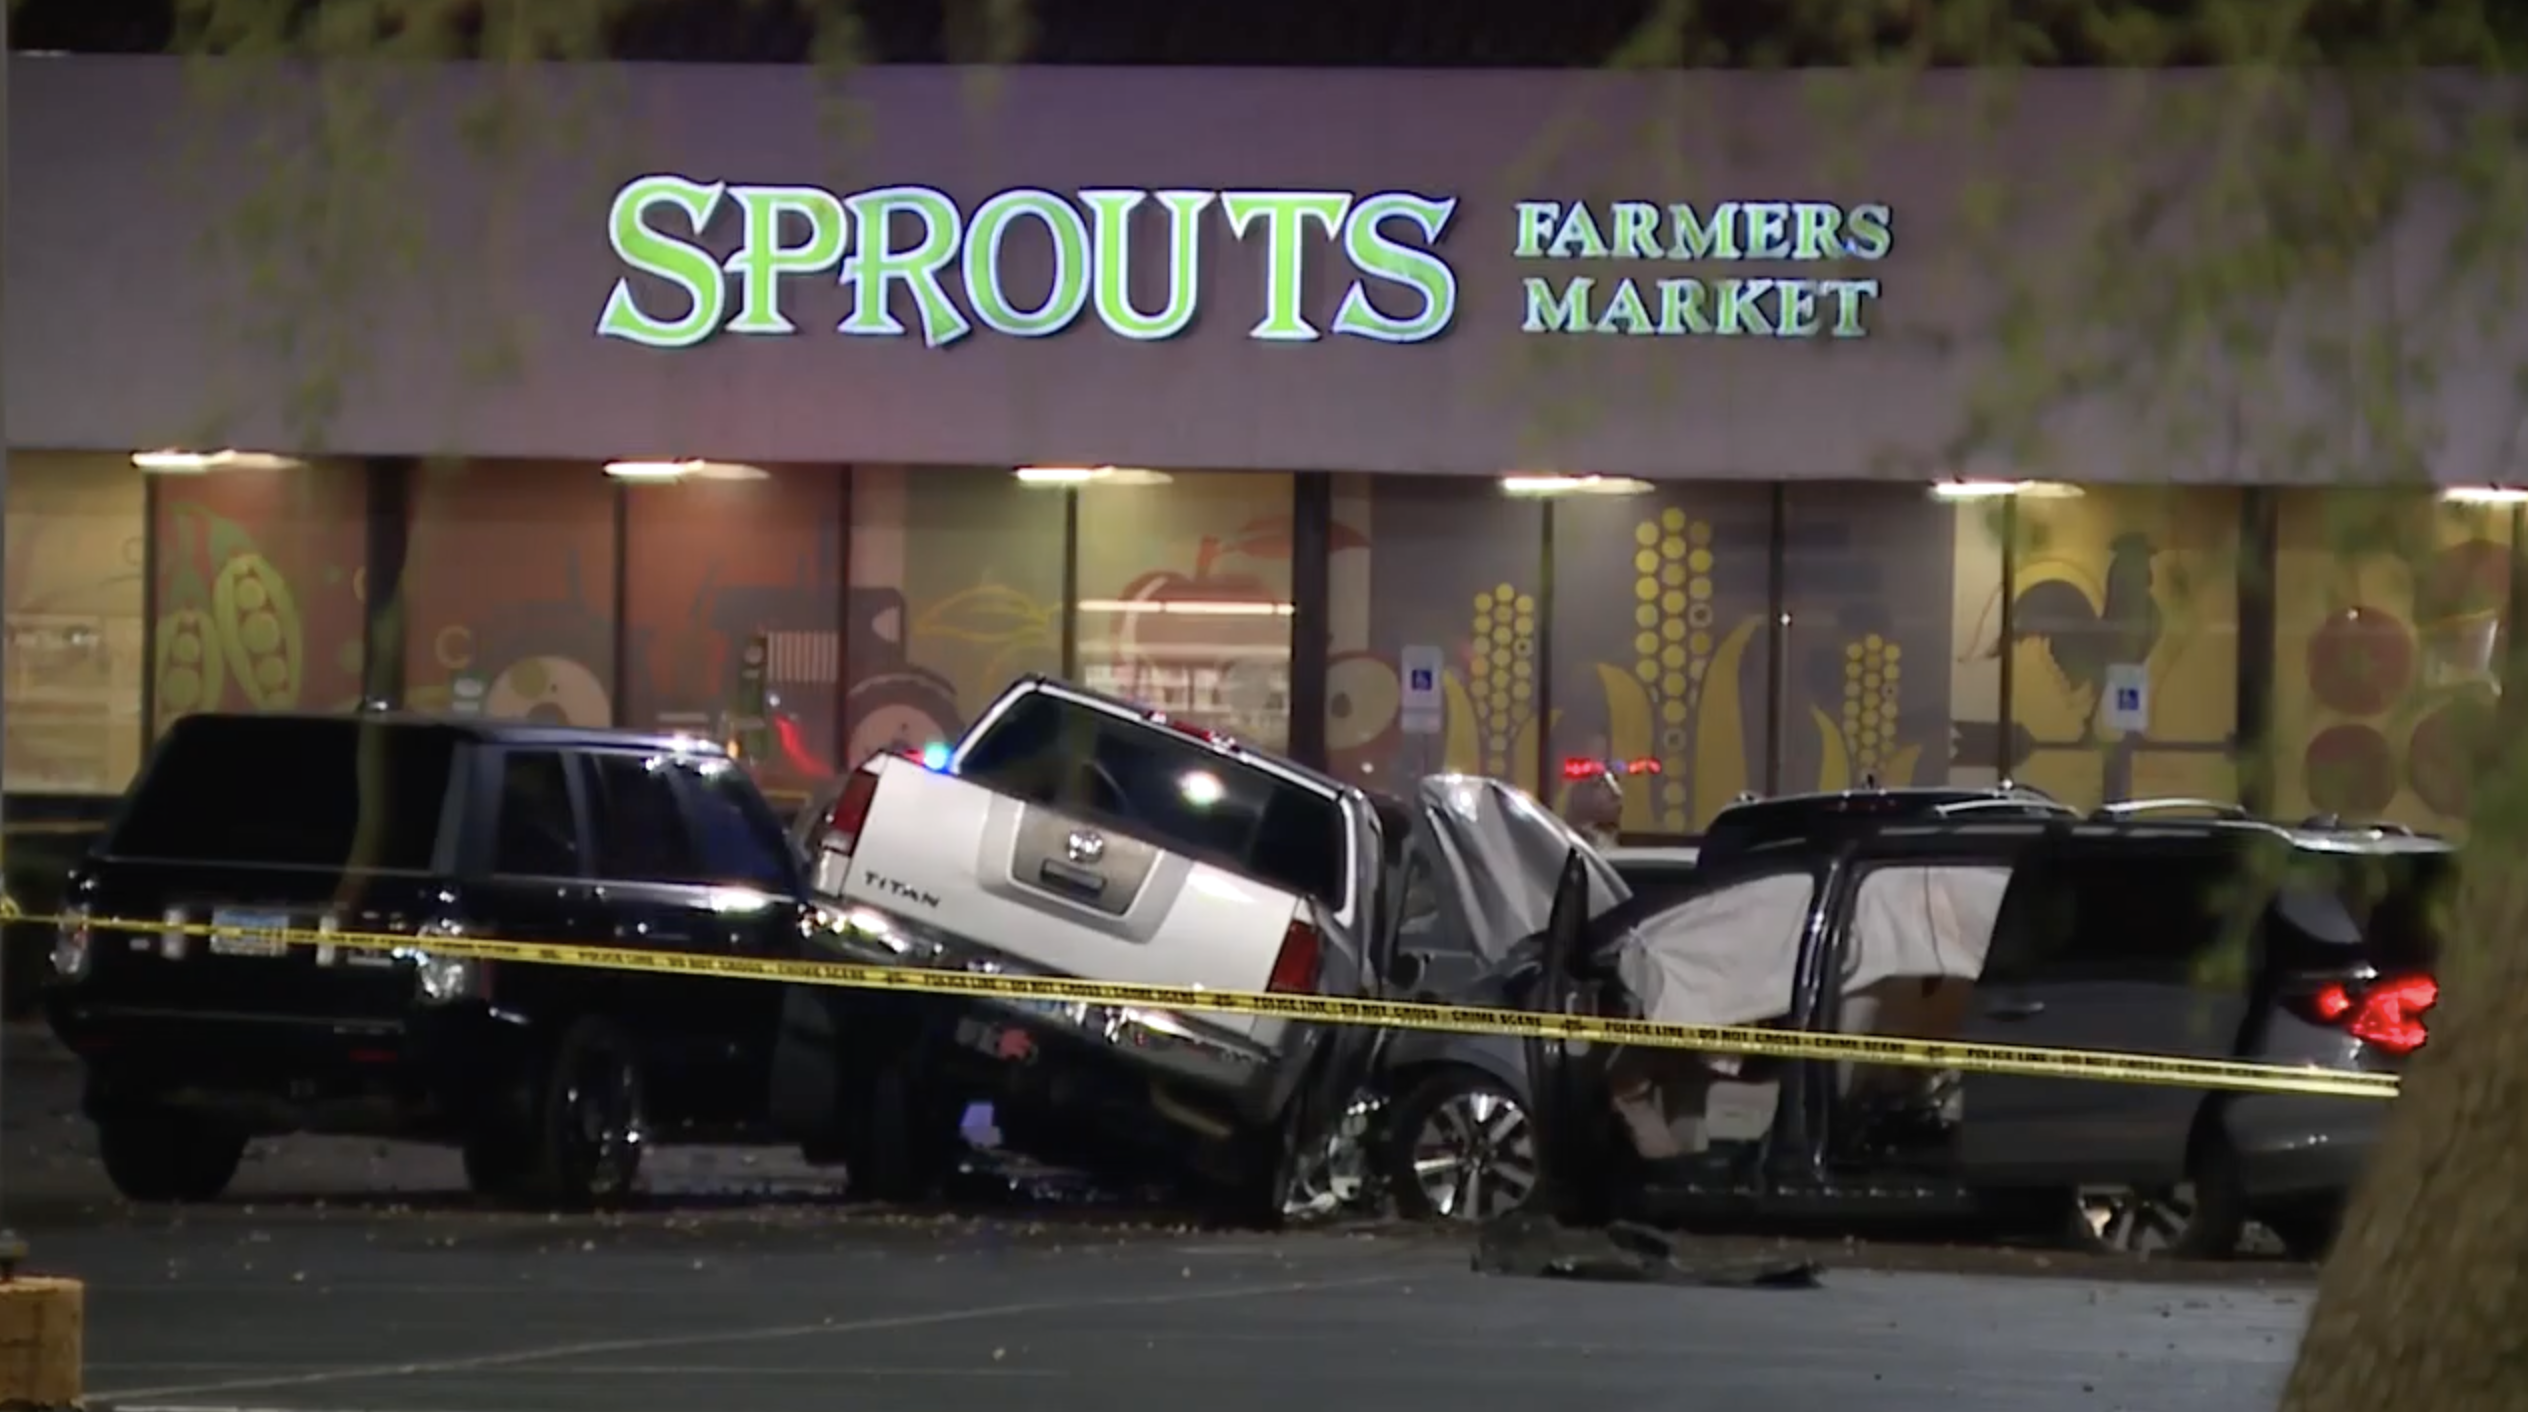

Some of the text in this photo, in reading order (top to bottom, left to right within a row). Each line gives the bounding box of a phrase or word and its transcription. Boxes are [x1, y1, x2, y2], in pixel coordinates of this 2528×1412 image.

[1514, 201, 1891, 260] FARMERS
[597, 173, 1459, 348] SPROUTS
[1522, 276, 1879, 337] MARKET
[865, 870, 940, 908] TITAN
[1604, 1021, 1652, 1035] POLICE
[1655, 1024, 1684, 1037] LINE
[1699, 1028, 1716, 1039] DO
[1720, 1029, 1747, 1042] NOT
[1755, 1032, 1800, 1045] CROSS
[1814, 1036, 1858, 1050] CRIME
[1967, 1047, 2014, 1061] POLICE
